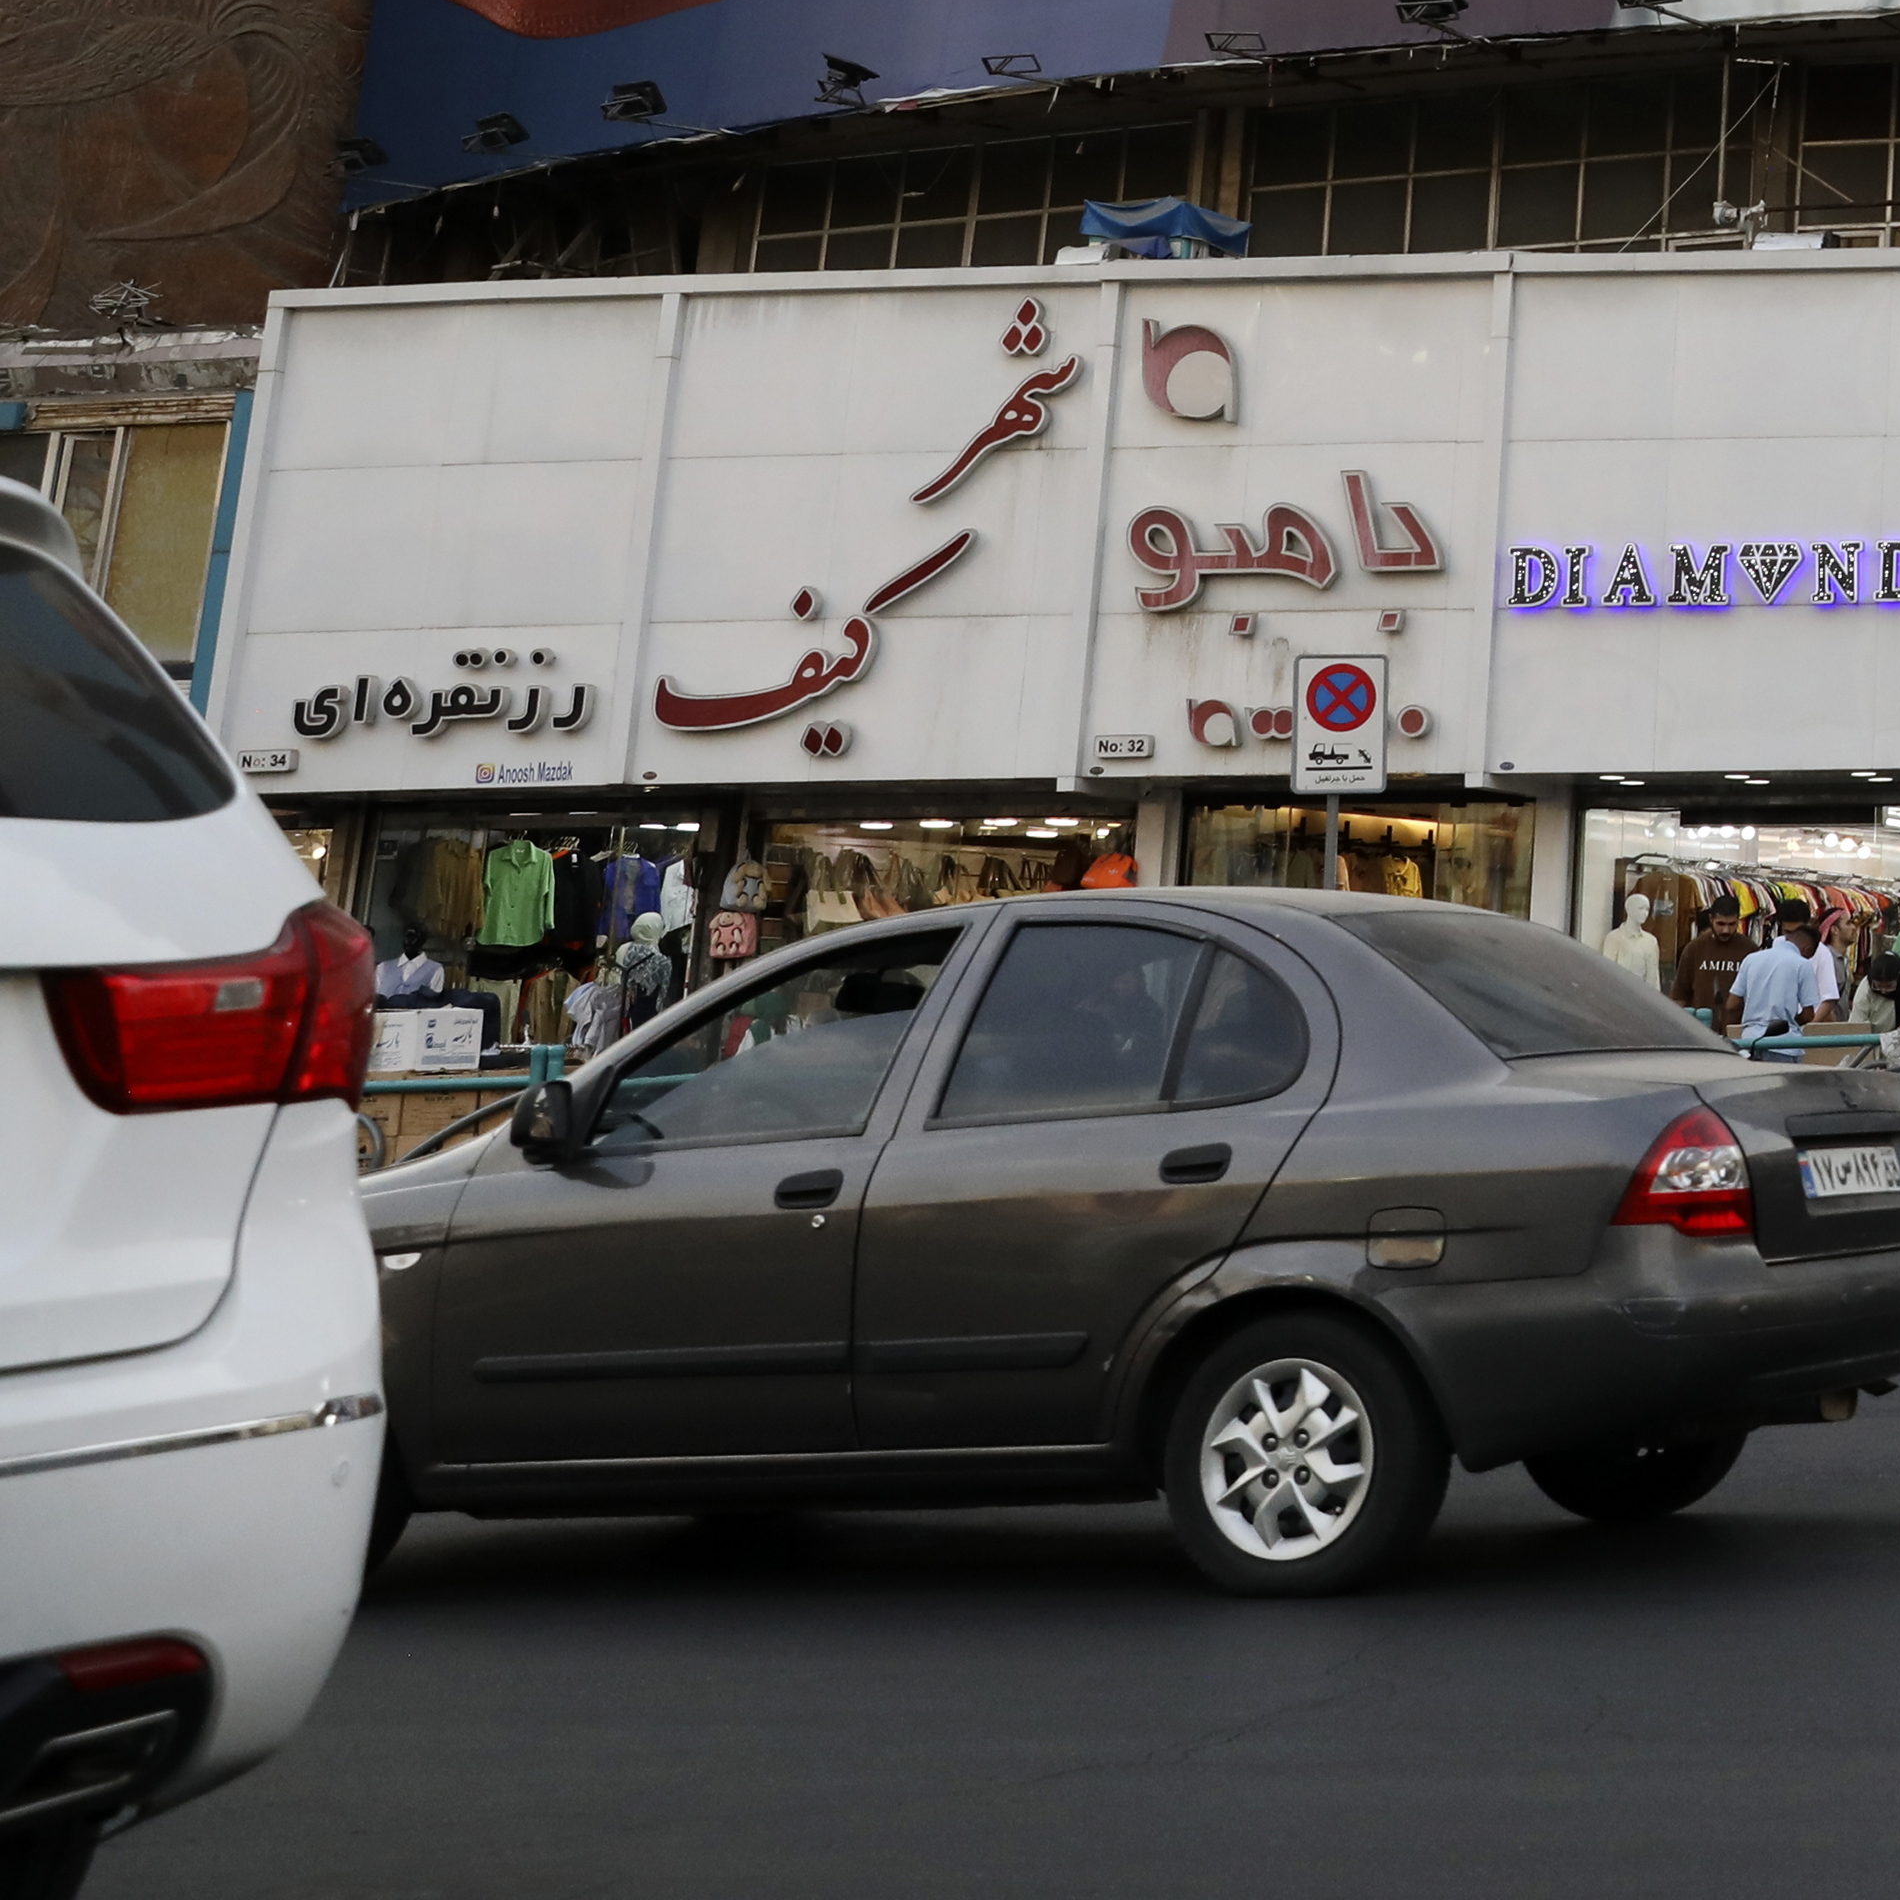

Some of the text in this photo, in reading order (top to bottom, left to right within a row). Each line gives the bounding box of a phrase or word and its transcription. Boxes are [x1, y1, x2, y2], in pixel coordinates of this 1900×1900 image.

[1126, 469, 1444, 637] بامبو
[654, 529, 977, 756] کیف
[1098, 739, 1145, 753] No: 32
[270, 753, 287, 767] 34
[1349, 774, 1366, 783] حمل
